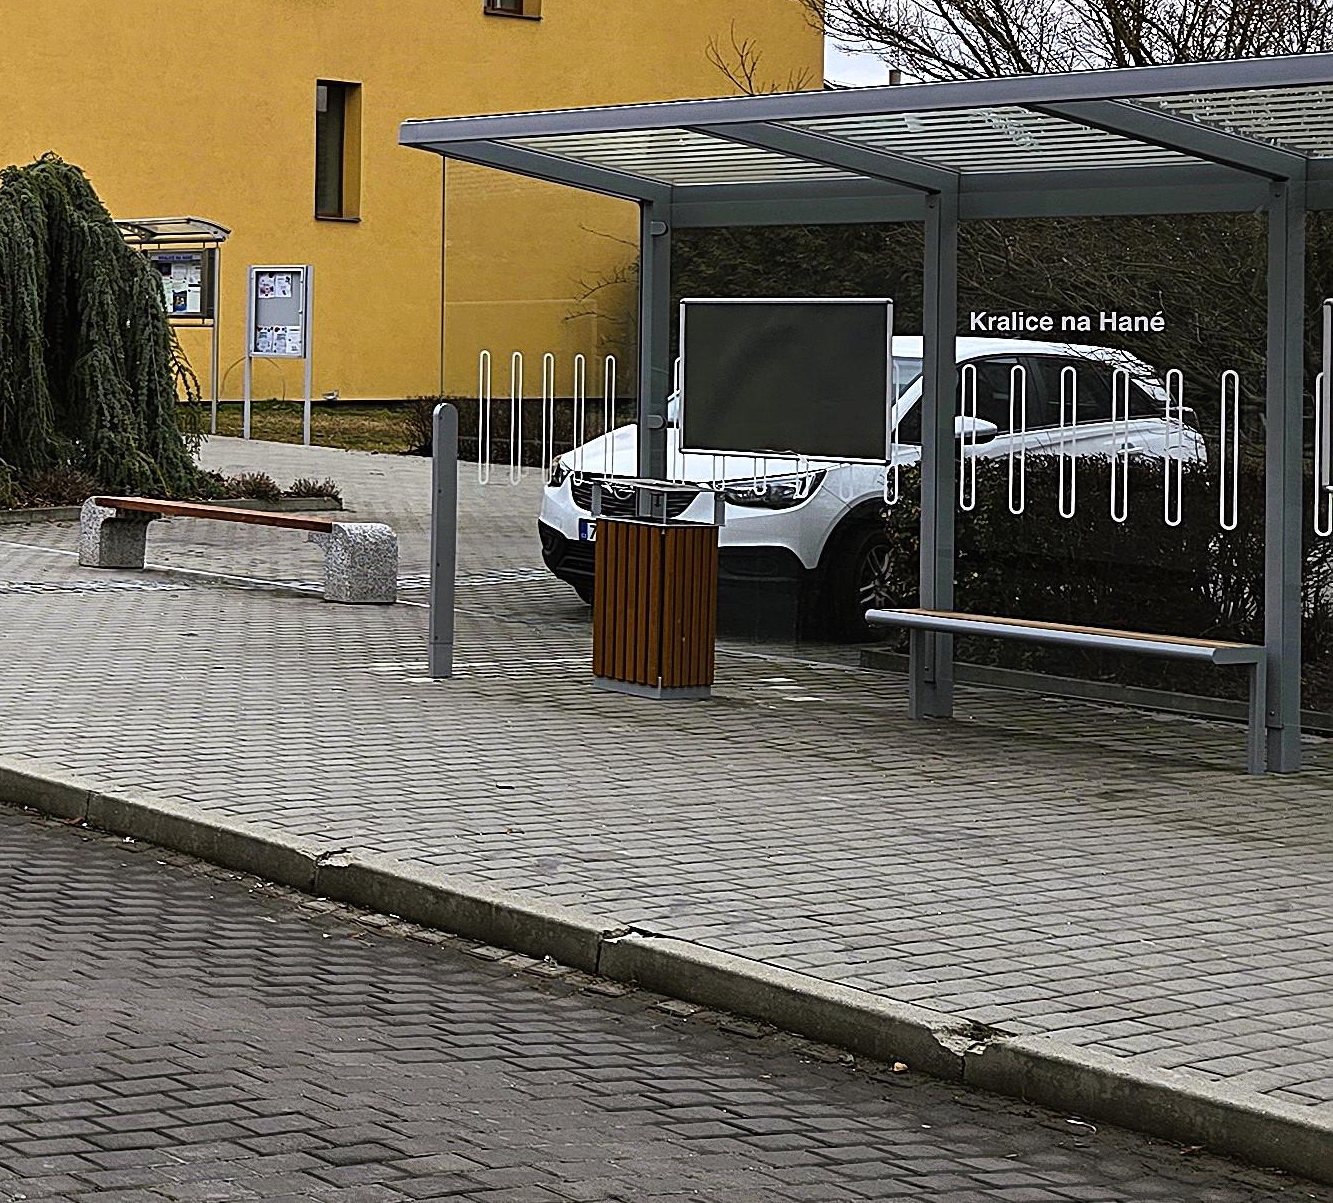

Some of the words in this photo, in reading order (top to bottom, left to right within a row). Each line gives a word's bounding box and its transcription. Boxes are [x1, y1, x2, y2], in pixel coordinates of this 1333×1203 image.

[969, 311, 1054, 332] Kralice
[1061, 315, 1091, 332] na
[1099, 310, 1166, 332] Hané
